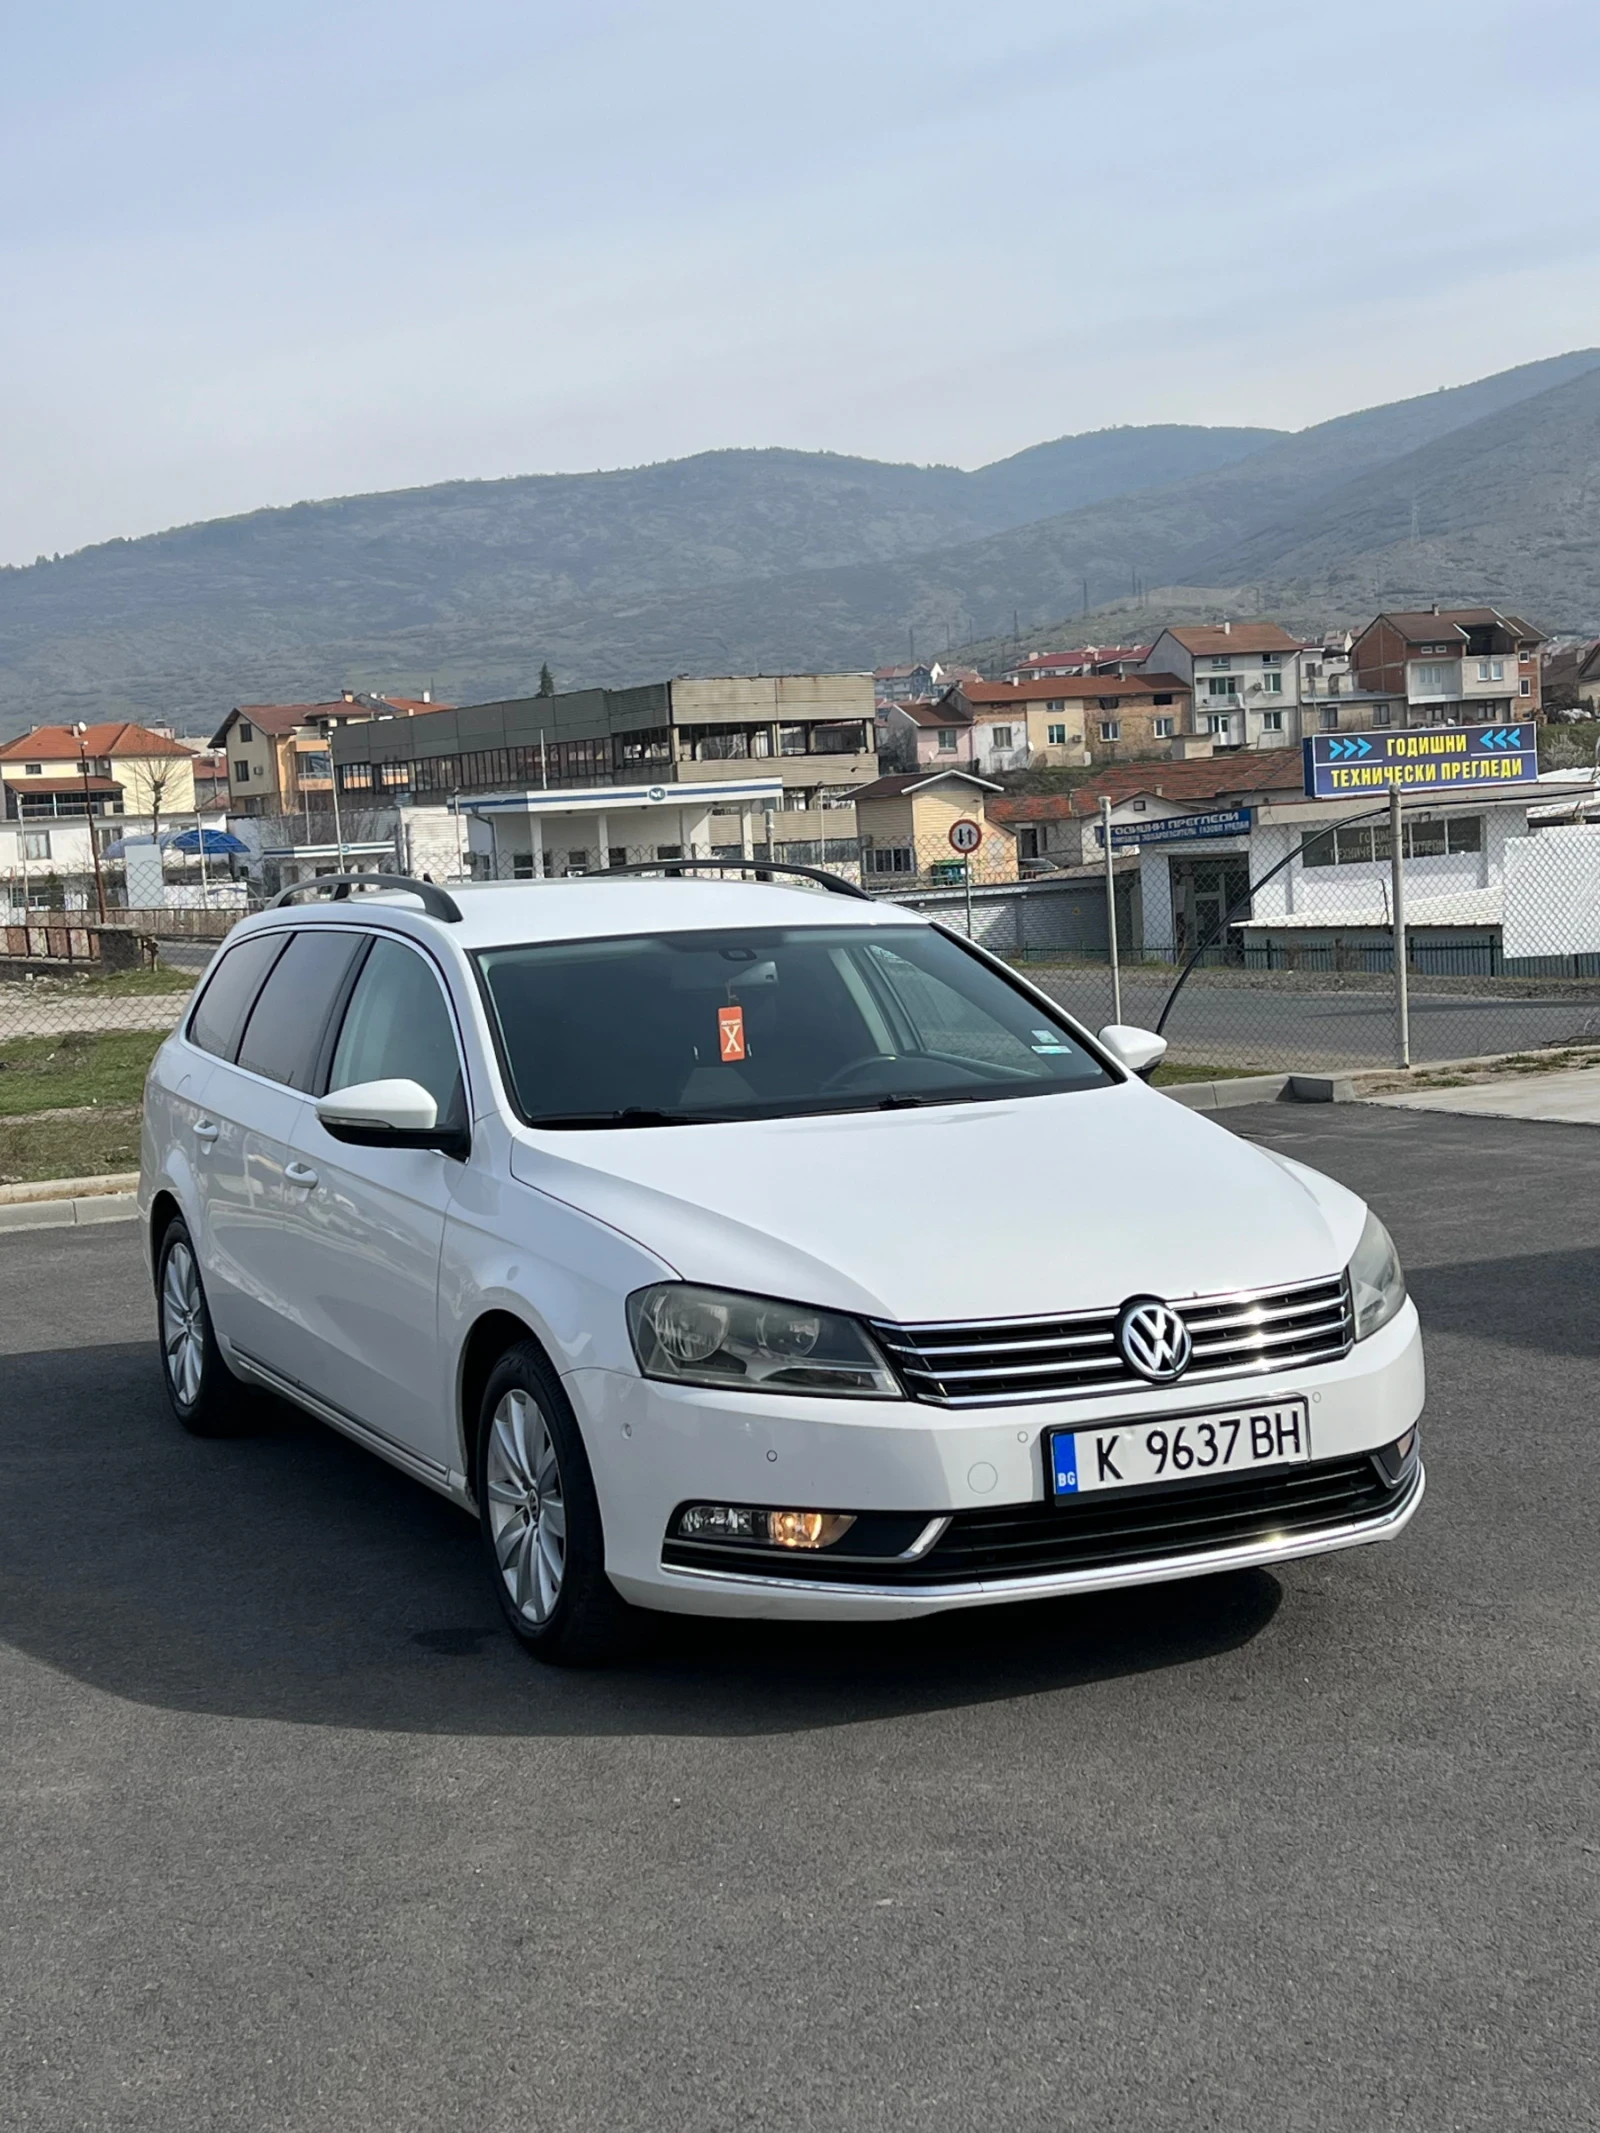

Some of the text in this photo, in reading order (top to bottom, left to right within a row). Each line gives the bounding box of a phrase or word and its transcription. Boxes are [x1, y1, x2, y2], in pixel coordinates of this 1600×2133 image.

[1386, 734, 1467, 757] ГОДИШНИ
[1331, 758, 1523, 788] ТЕХНИЧЕСКИ ПРЕГЛЕДИ
[1168, 811, 1239, 829] ПРЕГЛЕДИ
[722, 1025, 742, 1053] X
[1096, 1410, 1301, 1482] K 9637 BH
[1057, 1471, 1076, 1487] BG
